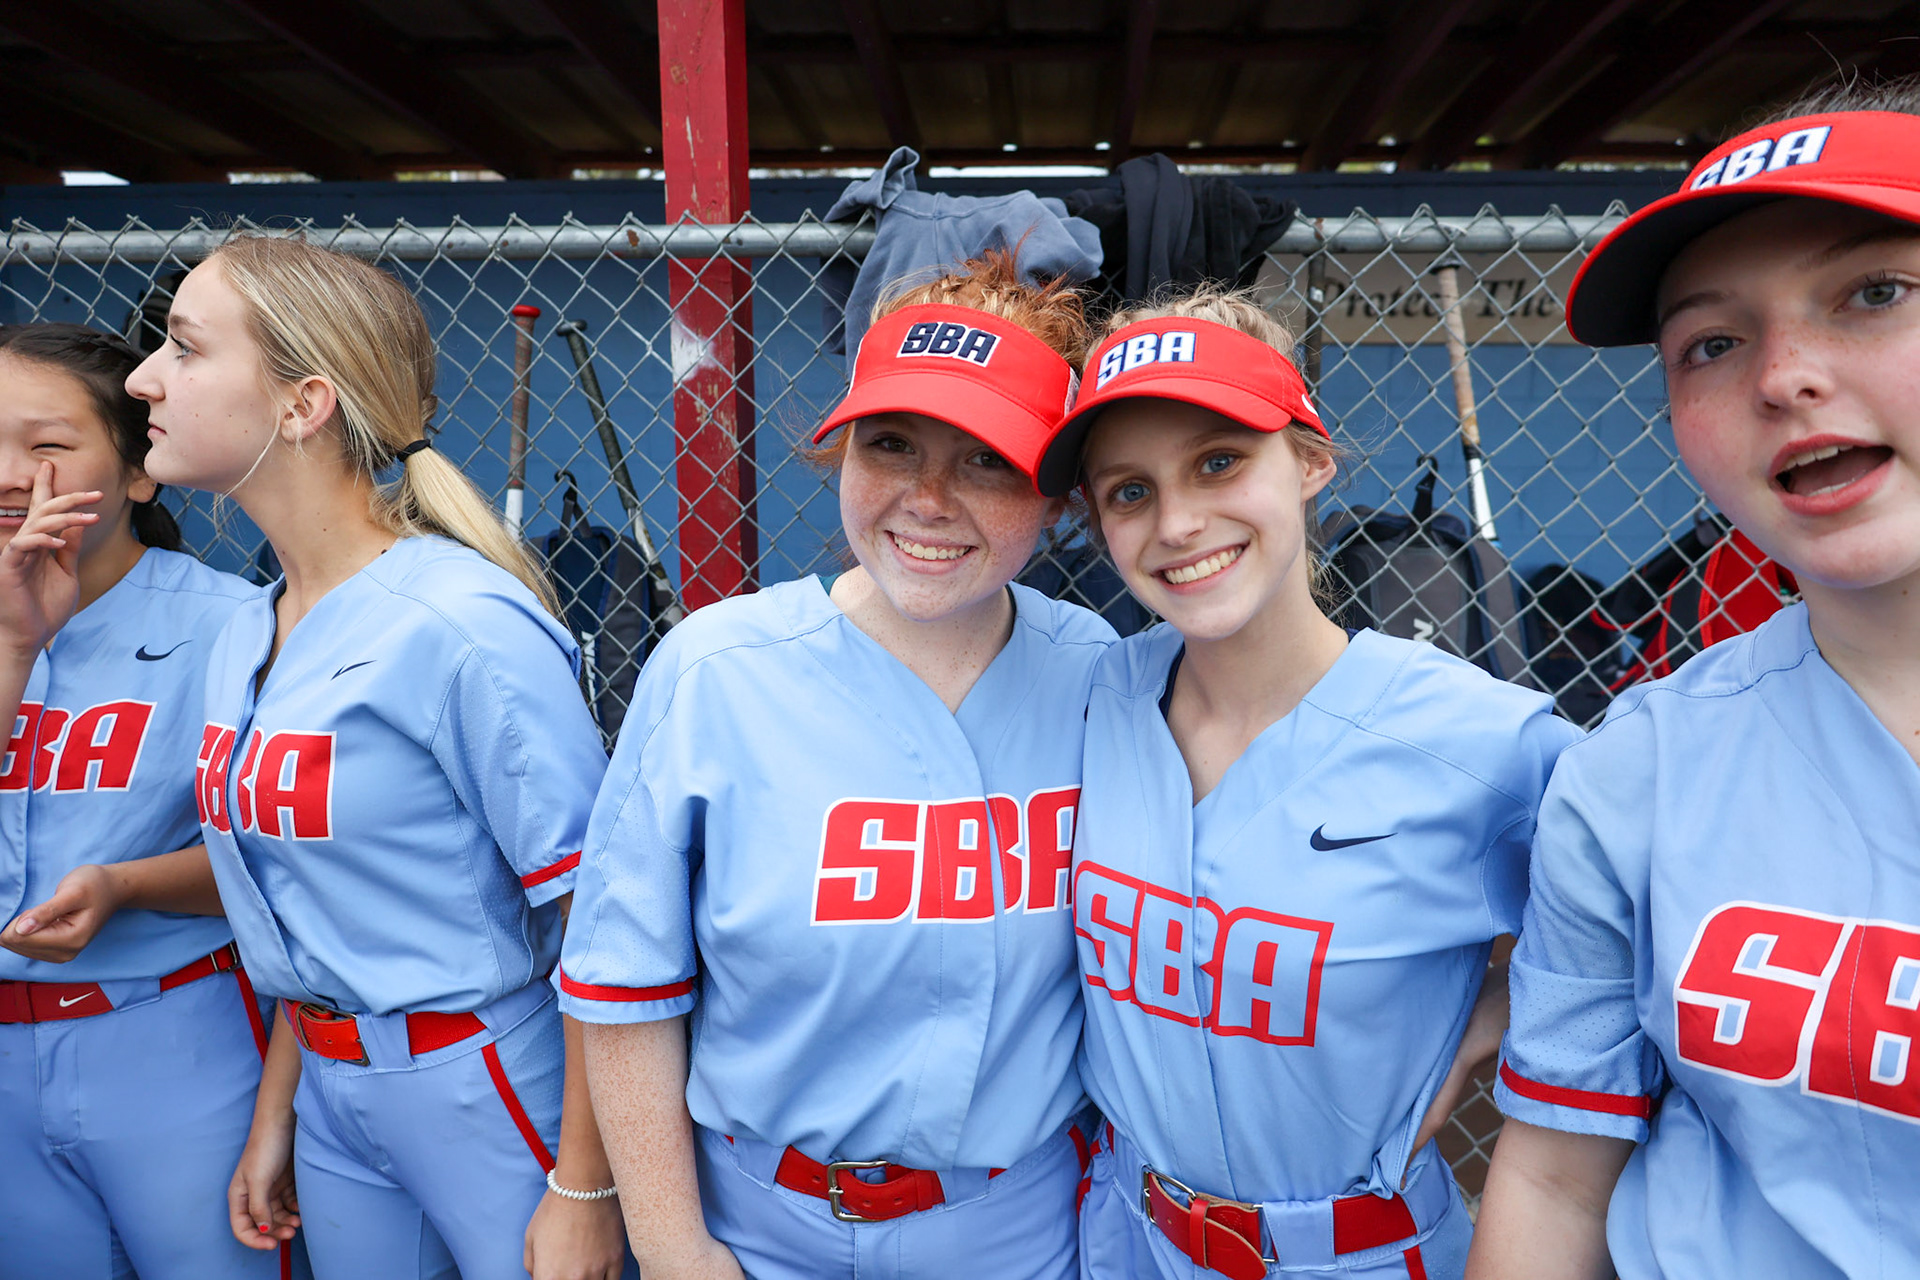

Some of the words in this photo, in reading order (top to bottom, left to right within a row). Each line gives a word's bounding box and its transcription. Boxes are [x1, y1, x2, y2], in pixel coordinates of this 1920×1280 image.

[1321, 276, 1446, 317] Protec
[1477, 279, 1561, 317] The
[897, 321, 1002, 368] SBA
[1096, 331, 1197, 391] SBA
[0, 698, 157, 795] BA
[1073, 859, 1334, 1047] SBA
[1673, 900, 1920, 1126] SB
